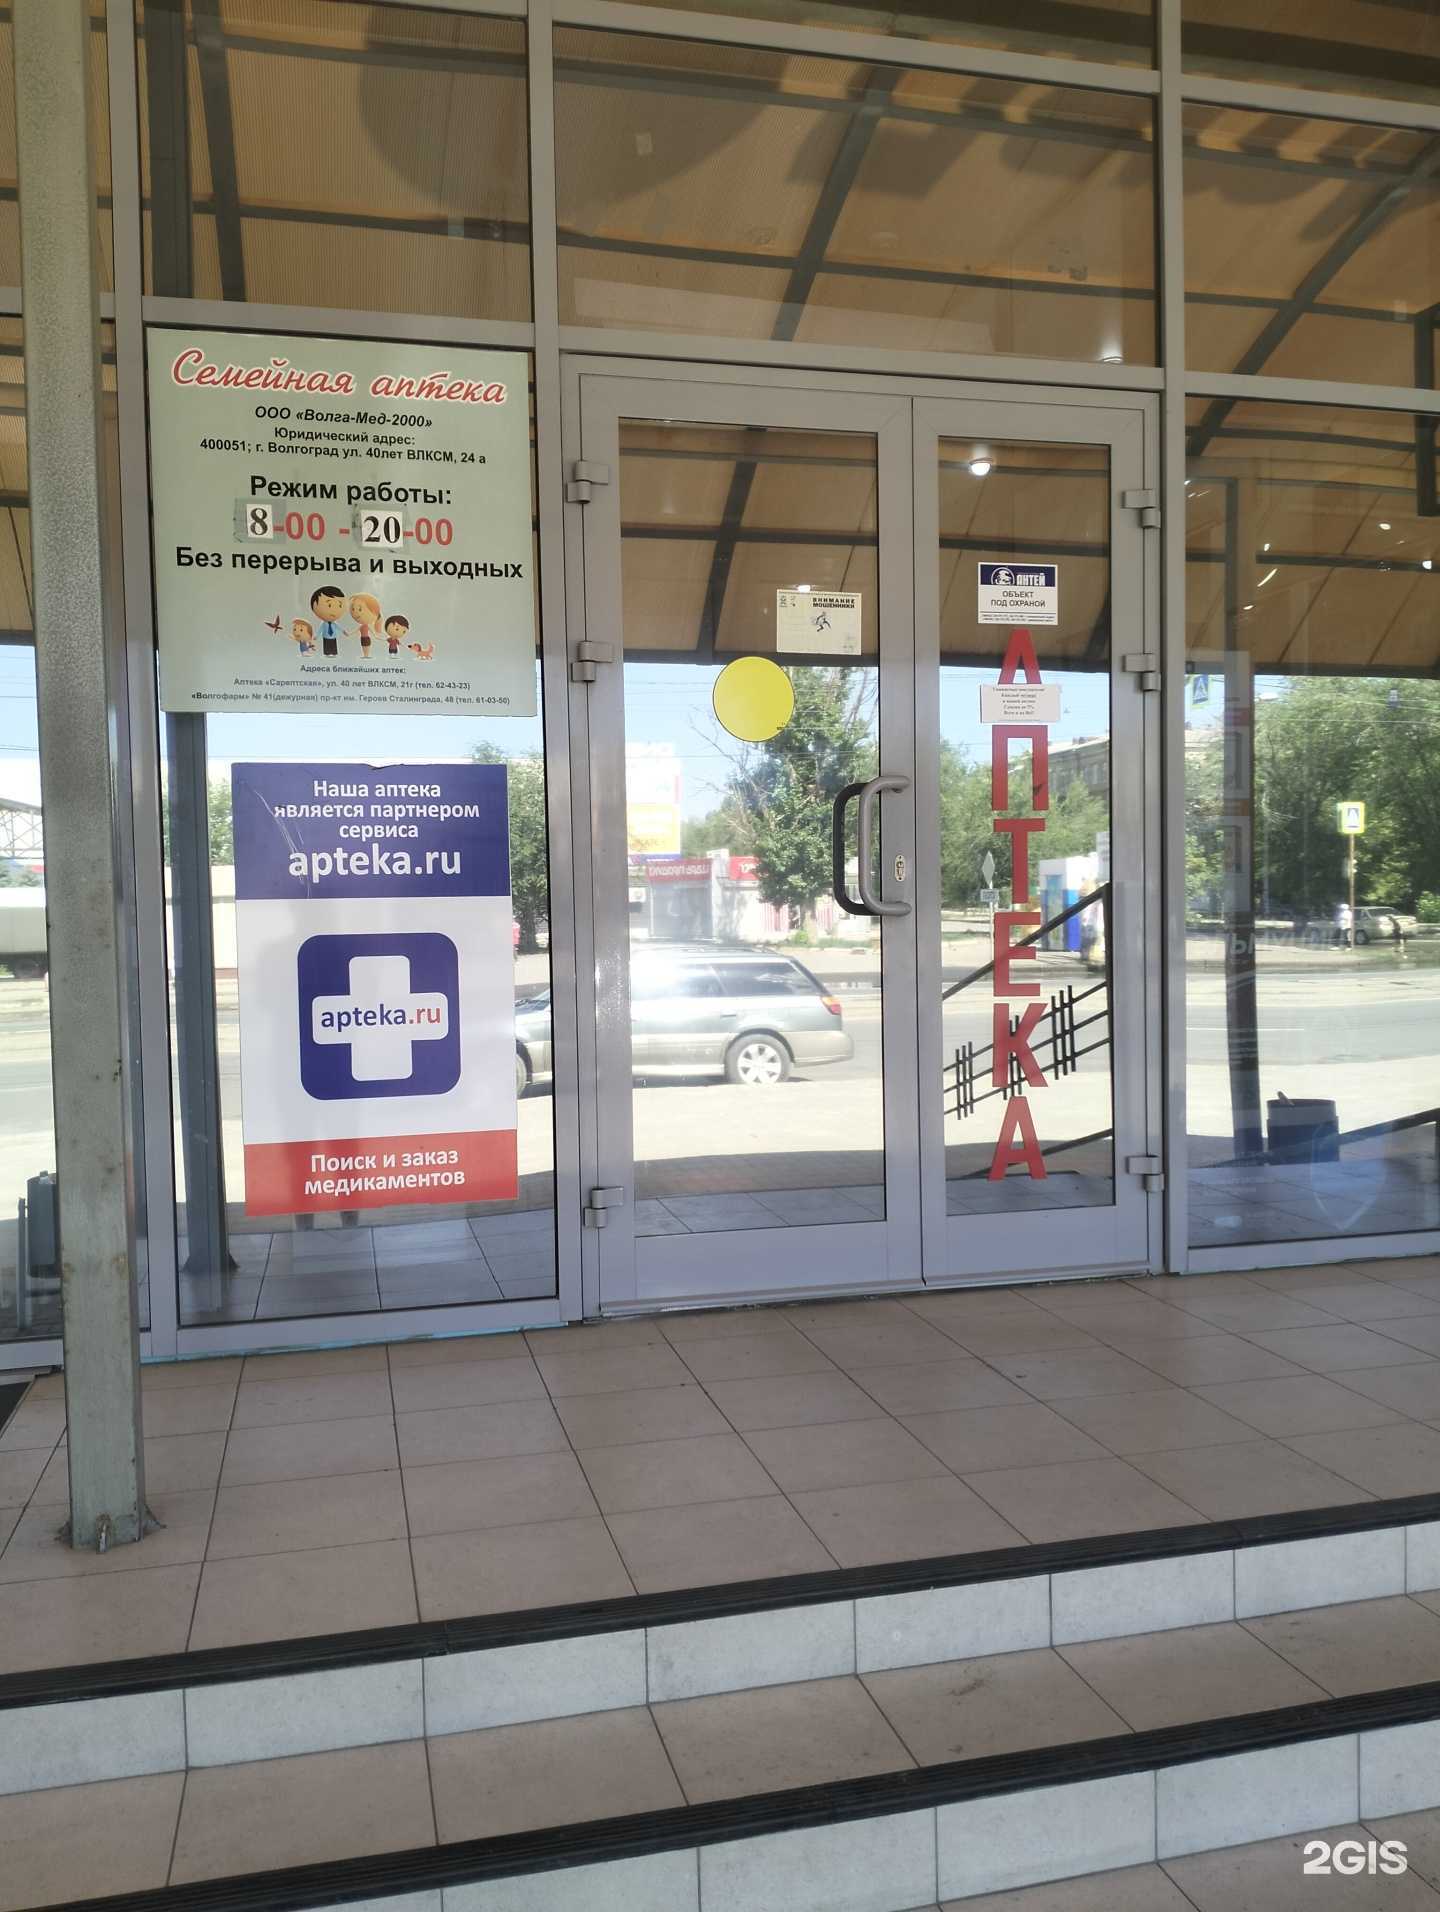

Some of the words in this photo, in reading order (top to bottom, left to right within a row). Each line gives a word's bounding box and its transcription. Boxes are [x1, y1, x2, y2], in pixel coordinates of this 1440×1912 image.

[172, 348, 354, 394] Семейная
[371, 373, 505, 403] аптека
[255, 406, 291, 421] ООО
[296, 408, 433, 428] «Волга-Мед-2000»
[274, 427, 369, 445] Юридический
[372, 432, 415, 448] адрес:
[200, 438, 251, 453] 400051;
[255, 443, 264, 454] г.
[268, 442, 339, 458] Волгоград
[342, 446, 363, 461] ул.
[366, 447, 403, 460] 40лет
[406, 449, 457, 464] ВЛКСМ,
[461, 452, 475, 463] 24
[250, 475, 338, 501] Режим
[347, 482, 453, 507] работы:
[249, 506, 326, 541] 8-00
[363, 515, 454, 546] 20-00
[176, 546, 223, 569] Без
[231, 551, 362, 576] перерыва
[370, 556, 384, 574] и
[393, 558, 524, 579] выходных
[991, 599, 1008, 607] ПОД
[1002, 590, 1034, 598] ОБЪЕКТ
[300, 664, 331, 674] Адреса
[332, 665, 379, 674] ближайших
[234, 678, 263, 686] Аптека
[191, 692, 249, 701] «Волгофарм»
[313, 780, 369, 798] Наша
[375, 783, 441, 798] аптека
[274, 804, 364, 819] является
[370, 804, 480, 822] партнером
[339, 823, 419, 842] сервиса
[288, 843, 461, 883] apteka.ru
[988, 629, 1049, 1181] АПТЕКА
[321, 1003, 441, 1032] apteka.ru
[311, 1153, 376, 1172] Поиск
[383, 1153, 395, 1168] и
[401, 1149, 459, 1166] заказ
[305, 1169, 465, 1197] медикаментов
